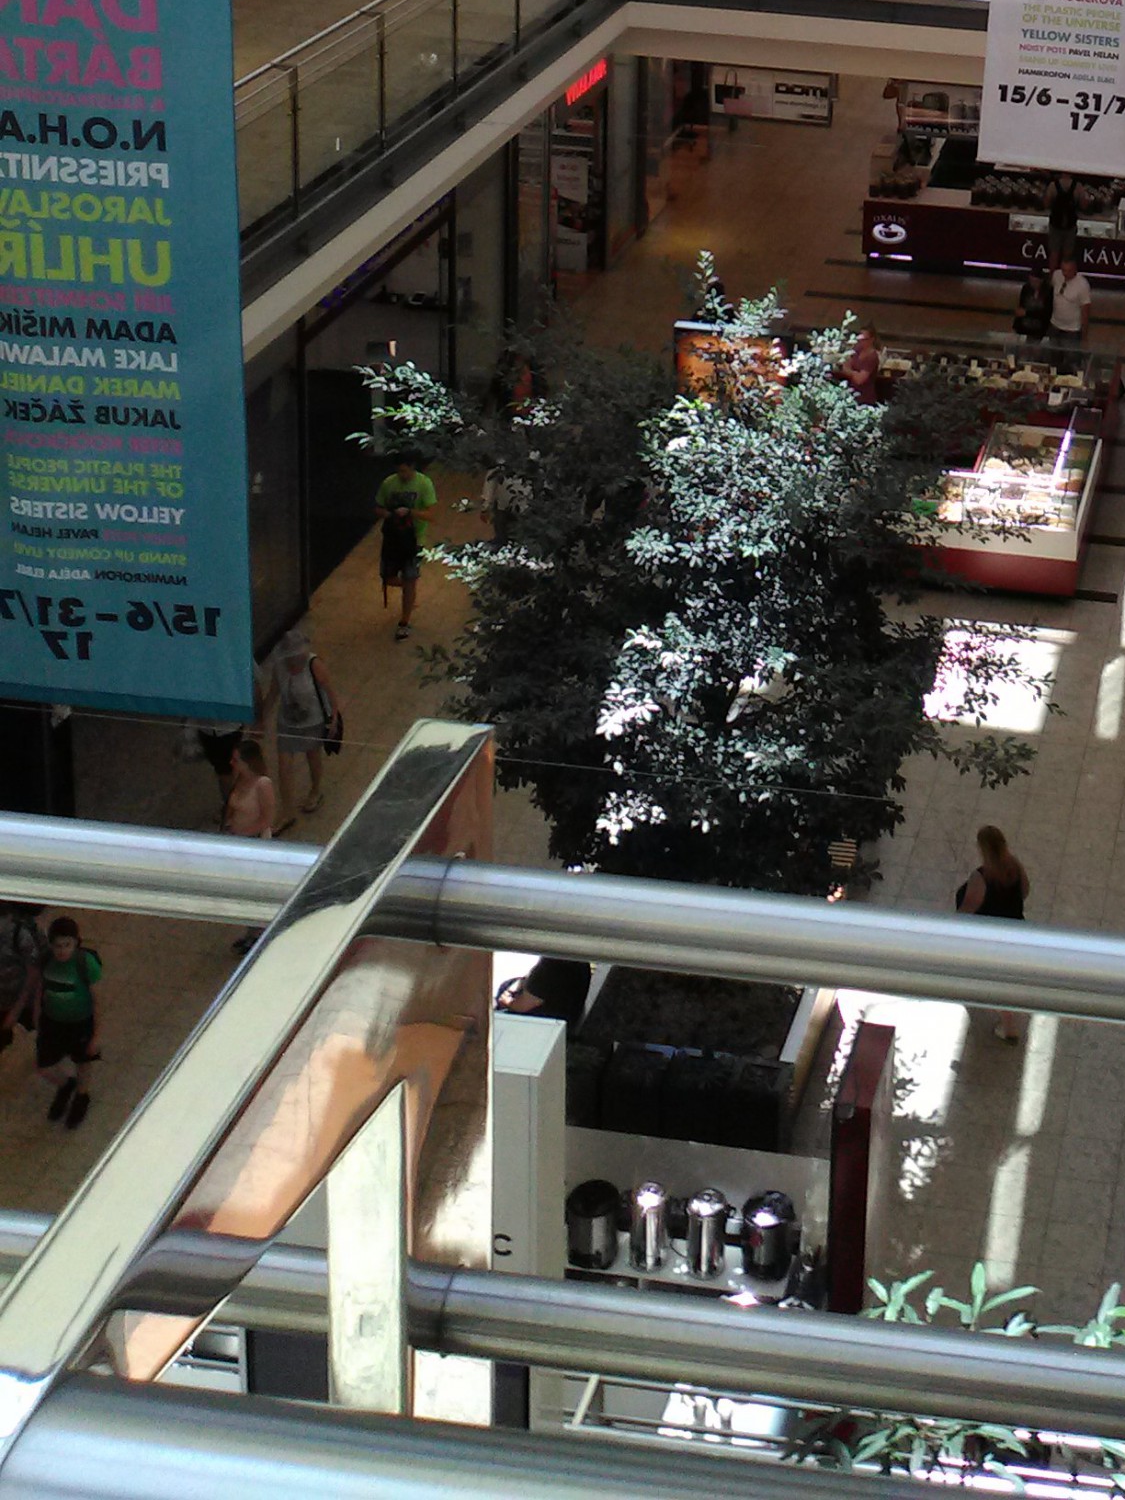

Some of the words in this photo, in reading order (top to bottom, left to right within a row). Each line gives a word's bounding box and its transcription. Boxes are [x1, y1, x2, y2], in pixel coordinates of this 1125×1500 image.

[1023, 3, 1040, 13] THE
[1044, 5, 1083, 17] PLASTIC
[1022, 13, 1038, 23] OF
[1041, 15, 1062, 26] THE
[1066, 18, 1121, 32] UNIVERSE
[1021, 28, 1071, 43] YELLOW
[1075, 33, 1120, 48] SISTERS
[1068, 48, 1091, 57] PAVEL
[1093, 51, 1120, 60] HELAN
[998, 84, 1052, 107] 15/6
[1069, 111, 1100, 132] 17
[1022, 239, 1048, 260] ČA
